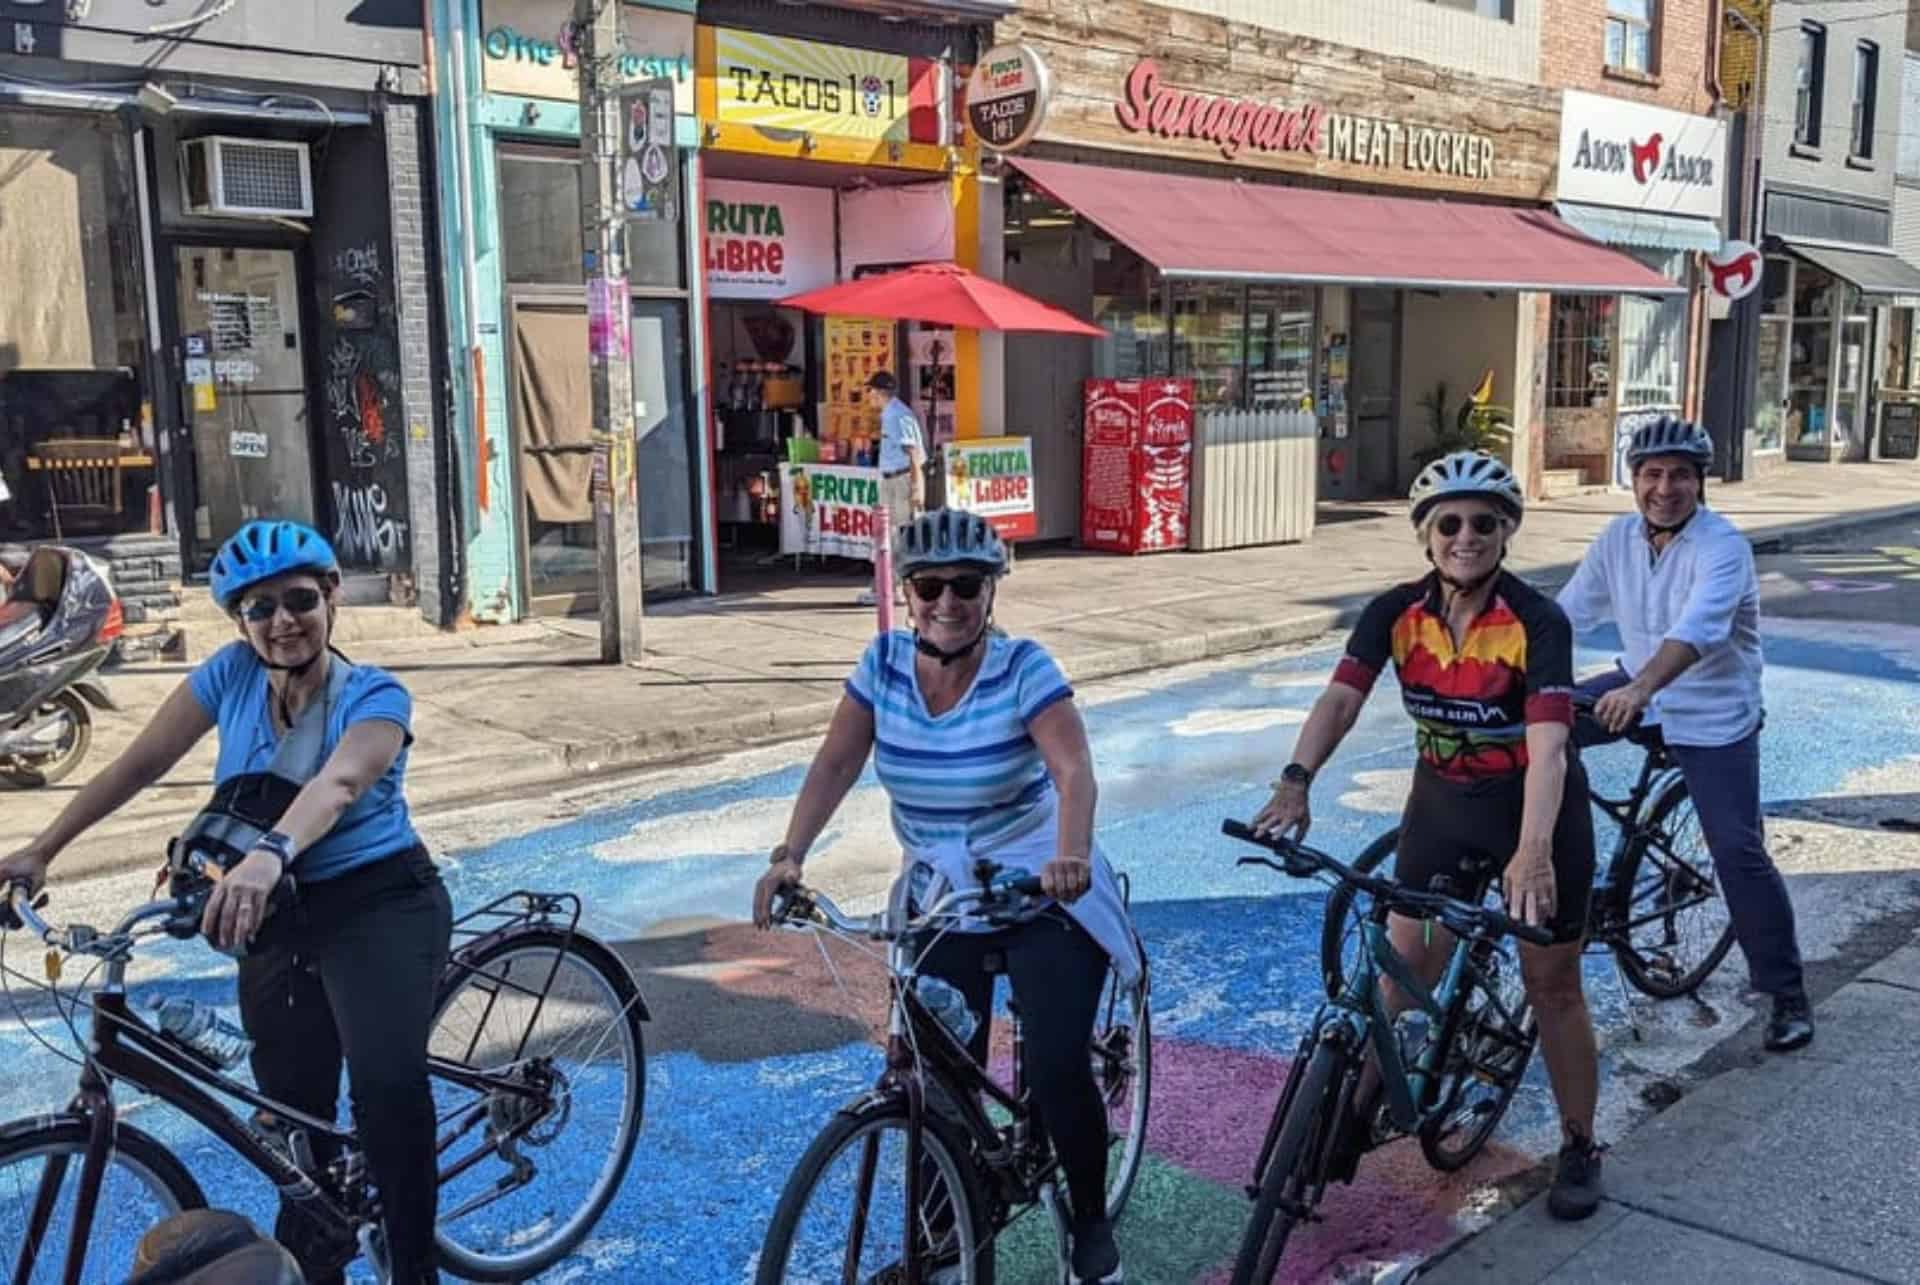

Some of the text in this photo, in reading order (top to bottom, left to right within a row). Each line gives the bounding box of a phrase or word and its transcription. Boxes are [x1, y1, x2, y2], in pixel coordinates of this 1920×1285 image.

[729, 66, 840, 113] TACOS
[1115, 57, 1494, 180] Sanagan's MEAT LOCKER
[707, 200, 785, 236] RUTA
[966, 448, 1028, 477] FRUTA
[811, 473, 879, 505] FRUTA
[818, 504, 873, 537] LiBR
